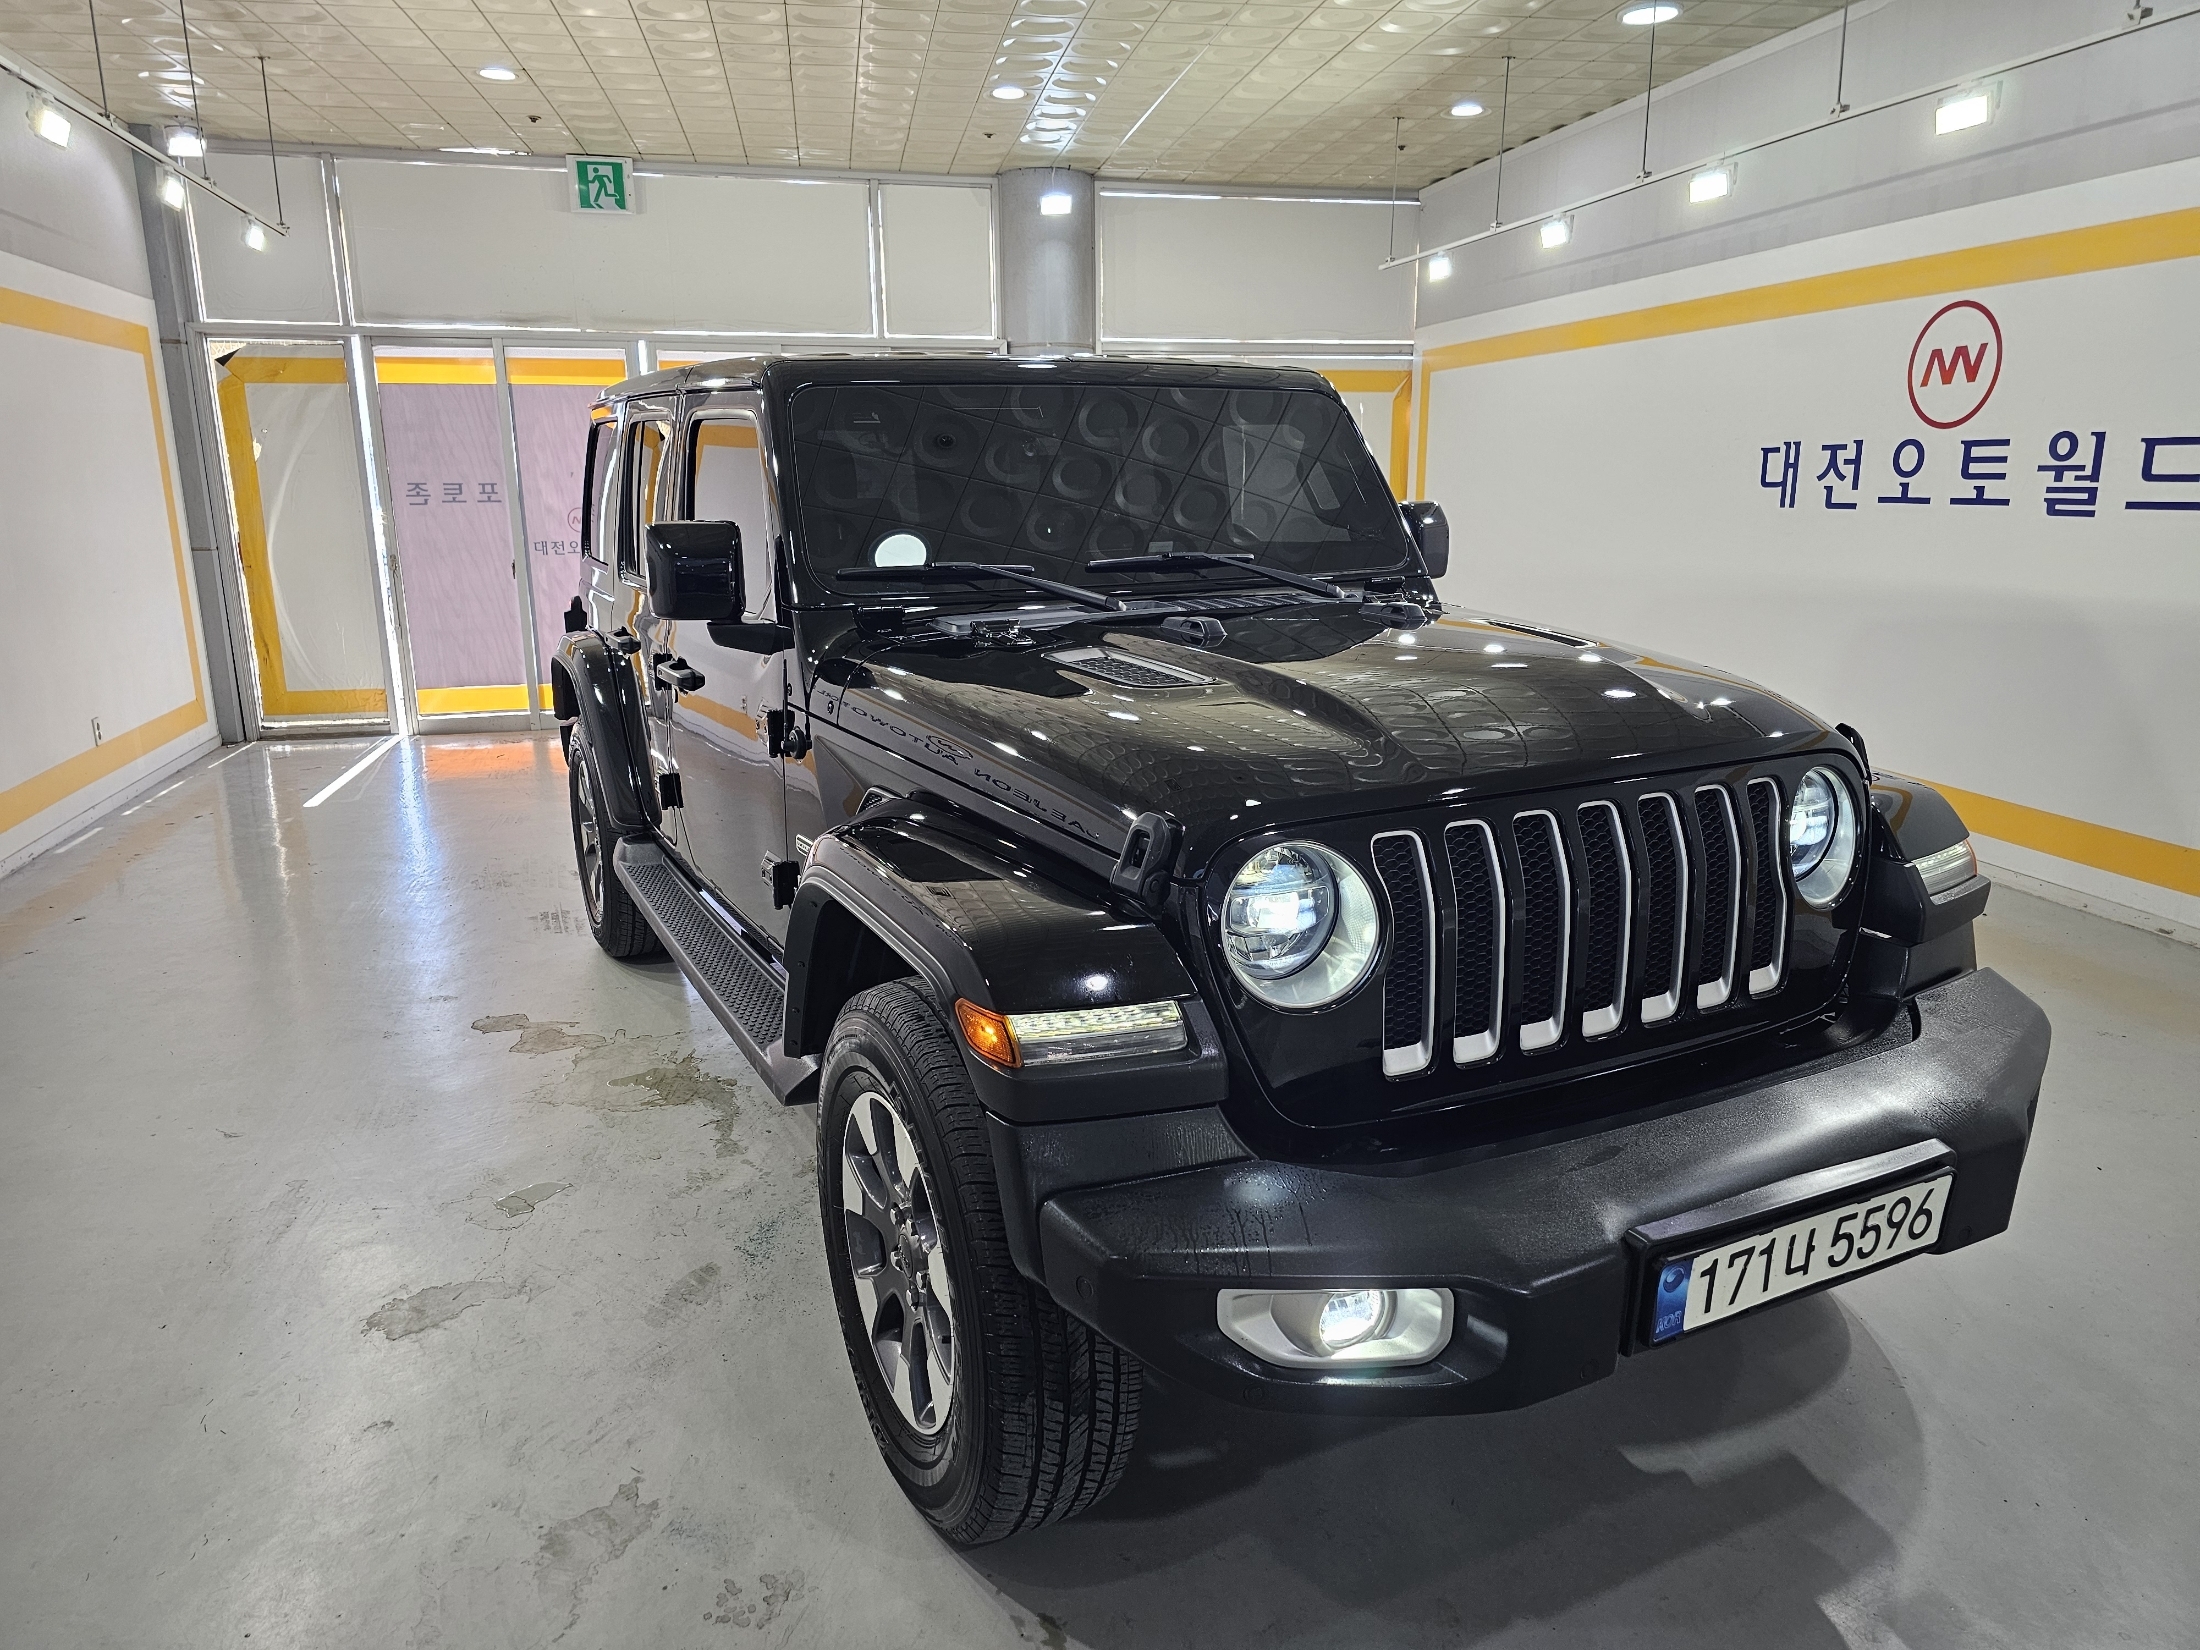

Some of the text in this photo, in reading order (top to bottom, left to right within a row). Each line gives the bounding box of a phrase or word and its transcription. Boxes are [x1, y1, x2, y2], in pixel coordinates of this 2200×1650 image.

[1760, 430, 2200, 518] 대전오토월드
[1700, 1187, 1934, 1314] 171나 5596
